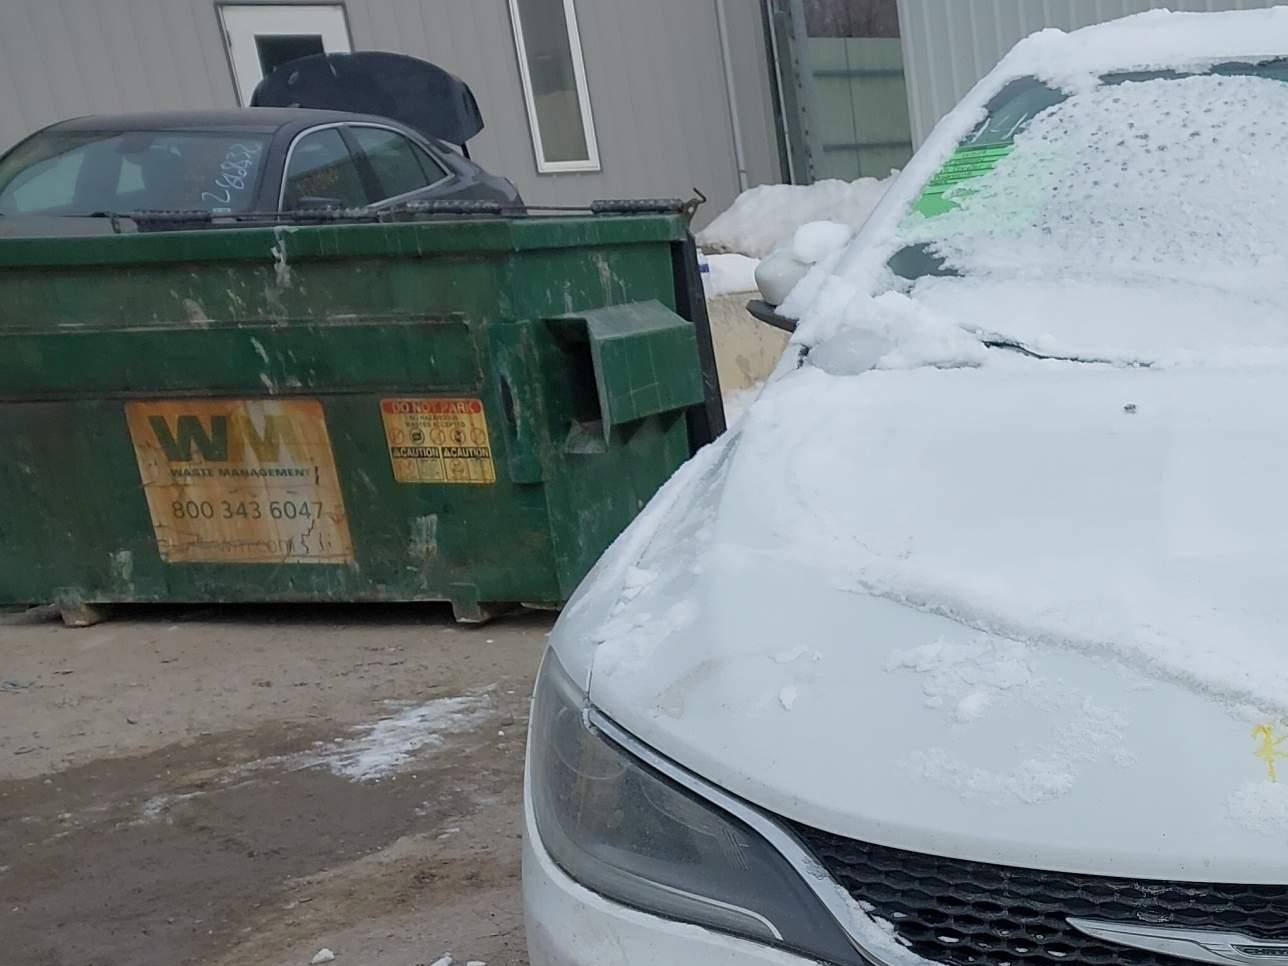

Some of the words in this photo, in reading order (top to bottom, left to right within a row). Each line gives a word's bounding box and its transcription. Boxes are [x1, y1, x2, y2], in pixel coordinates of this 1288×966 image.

[391, 401, 410, 413] DO
[412, 401, 438, 413] NOT
[400, 448, 439, 457] CAUTION
[451, 448, 488, 457] CAUTION
[170, 467, 214, 478] WASTE
[218, 467, 311, 478] MANAGEMENT
[171, 501, 214, 520] 800
[222, 501, 262, 520] 343
[269, 502, 323, 520] 6047
